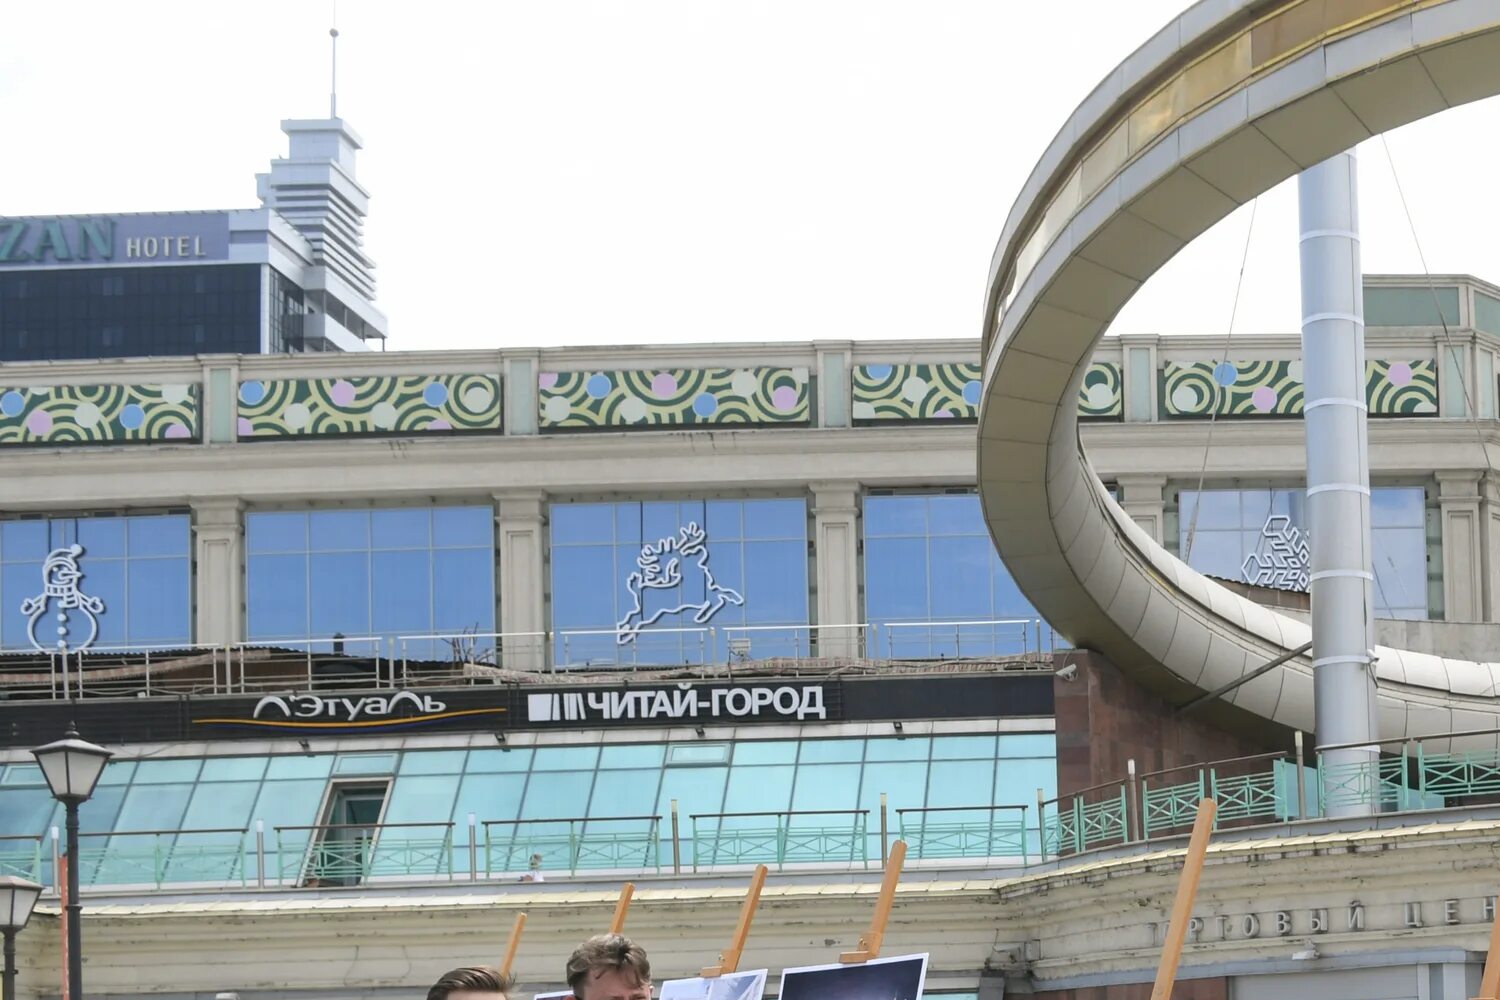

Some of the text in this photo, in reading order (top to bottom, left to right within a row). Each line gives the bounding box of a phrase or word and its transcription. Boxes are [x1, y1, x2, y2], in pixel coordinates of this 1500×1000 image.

[126, 236, 207, 258] HOTEL
[587, 682, 827, 720] ЧИТАЙ-ГОРОД
[1146, 901, 1364, 946] ТРГОВЫЙ
